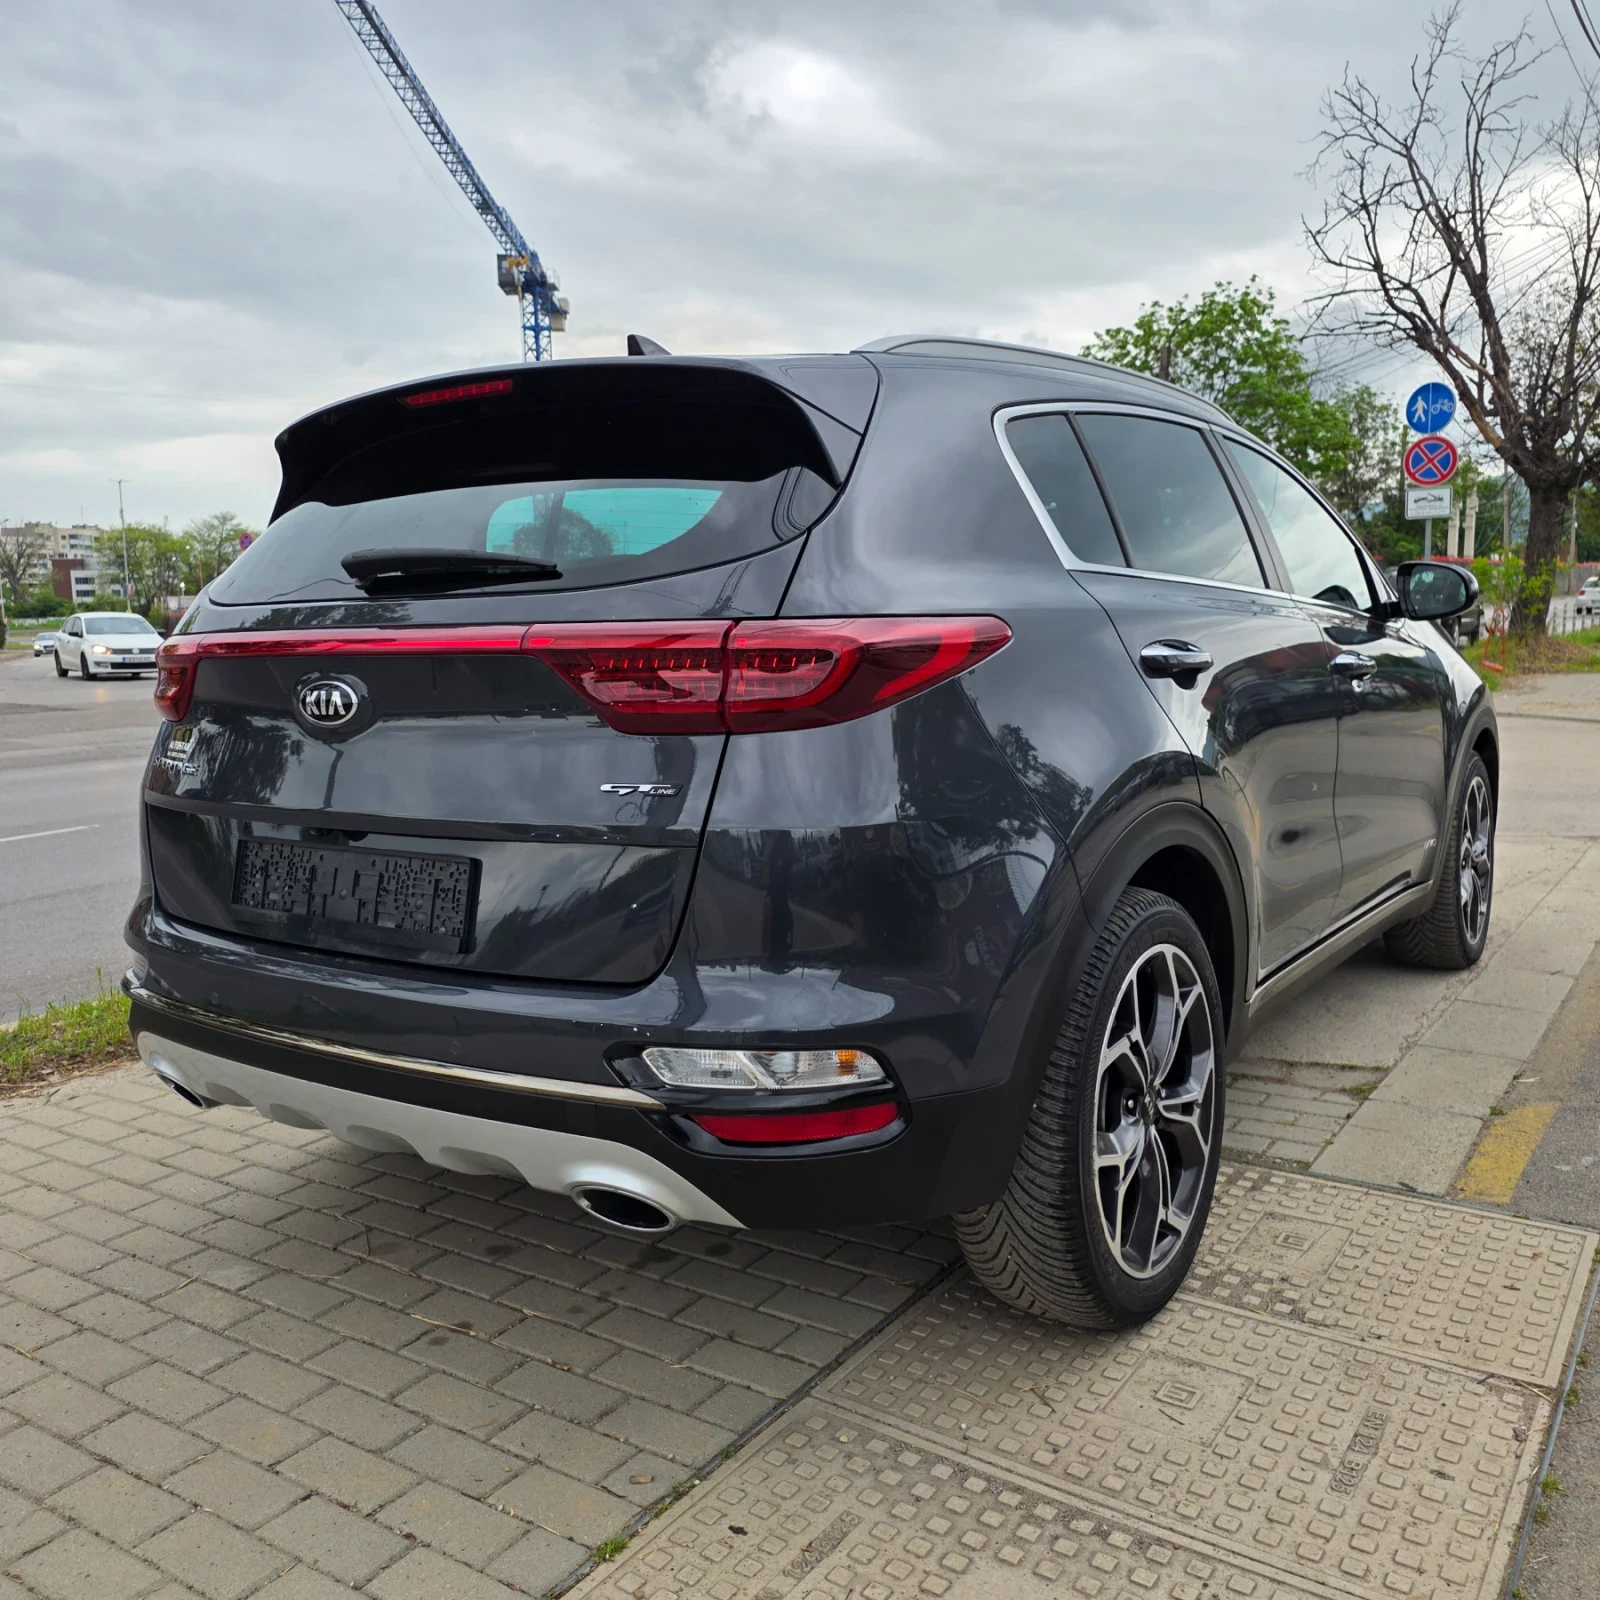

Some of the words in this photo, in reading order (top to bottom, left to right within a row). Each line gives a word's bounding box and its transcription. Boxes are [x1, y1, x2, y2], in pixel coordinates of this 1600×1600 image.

[305, 690, 346, 716] KIA
[600, 783, 672, 796] GT
[1363, 1408, 1387, 1429] EN
[1351, 1431, 1376, 1454] 124
[1331, 1458, 1362, 1496] B125
